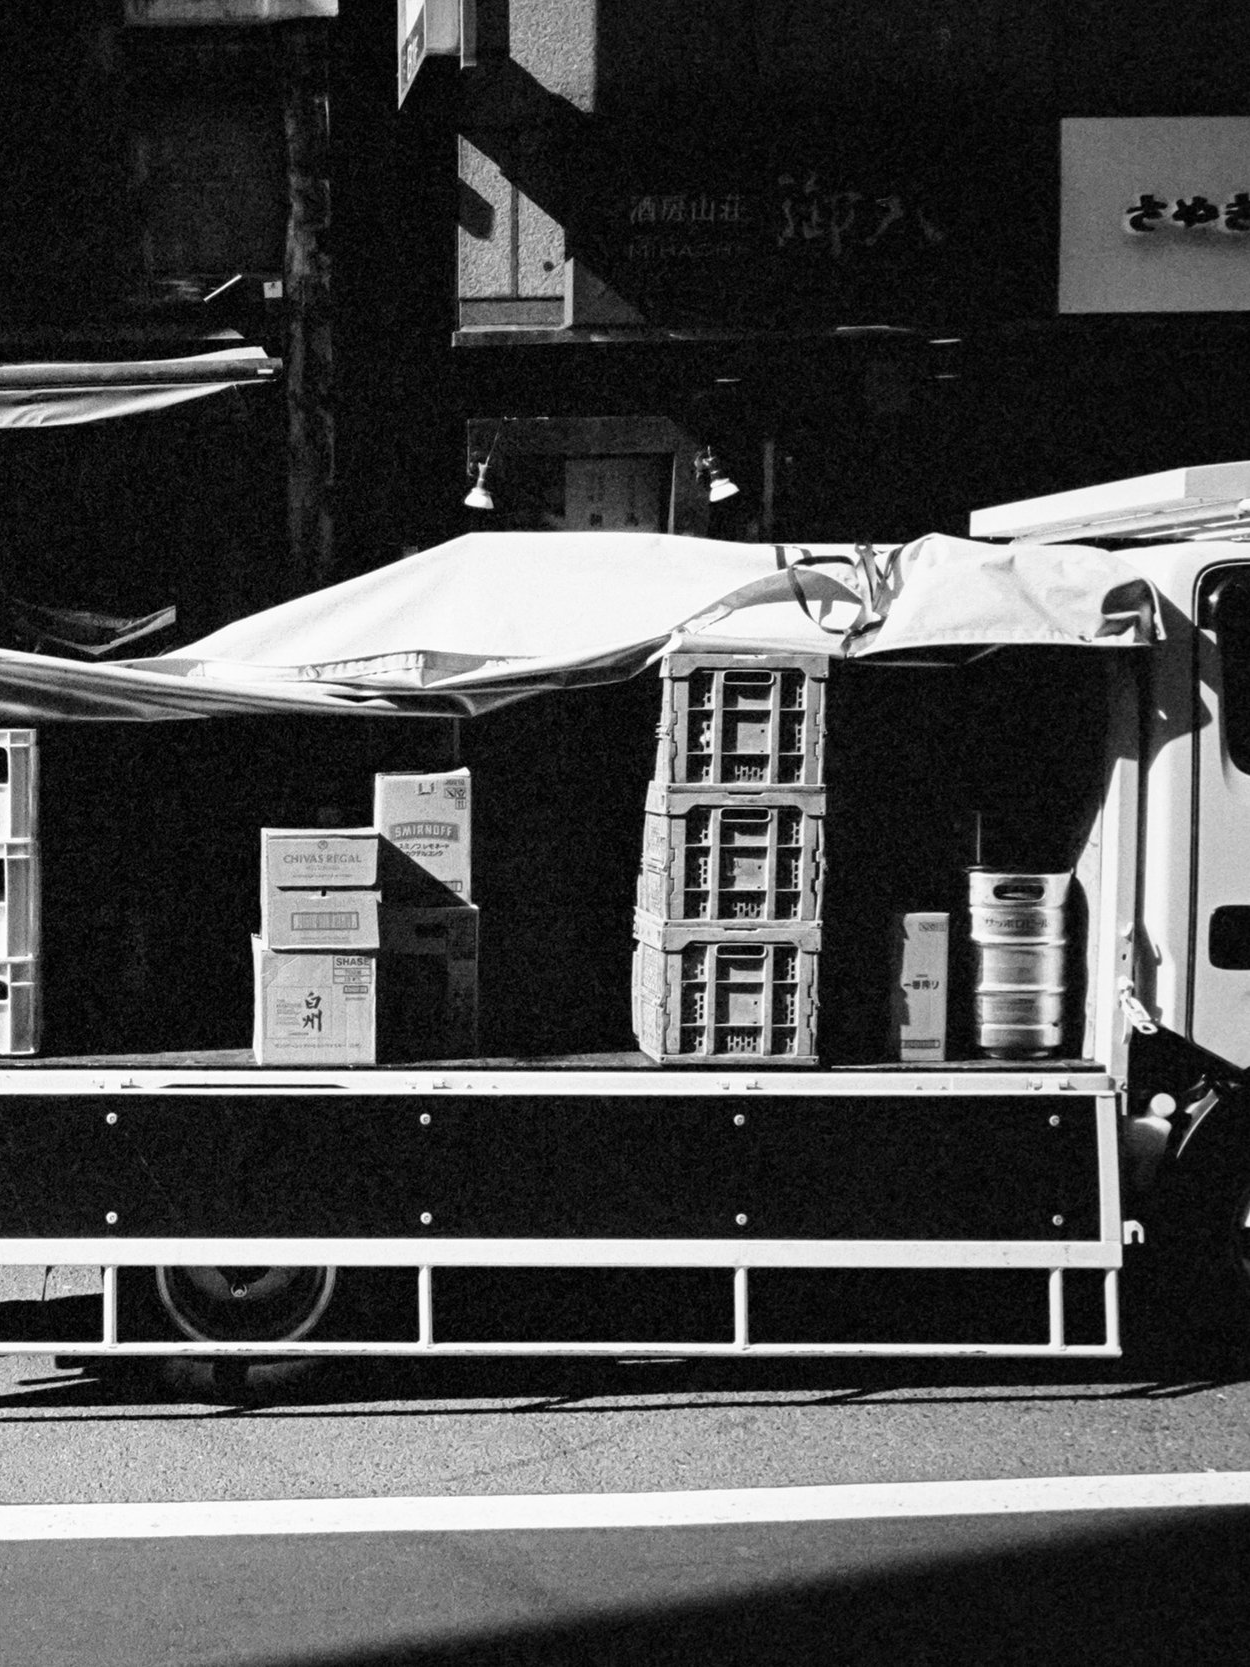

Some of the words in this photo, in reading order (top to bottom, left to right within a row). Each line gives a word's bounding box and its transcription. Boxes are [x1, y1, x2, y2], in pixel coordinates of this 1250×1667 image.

[394, 824, 452, 838] SMIRNOFF
[283, 853, 323, 864] CHIVAS
[326, 853, 362, 864] REGAL
[302, 991, 323, 1032] 白州
